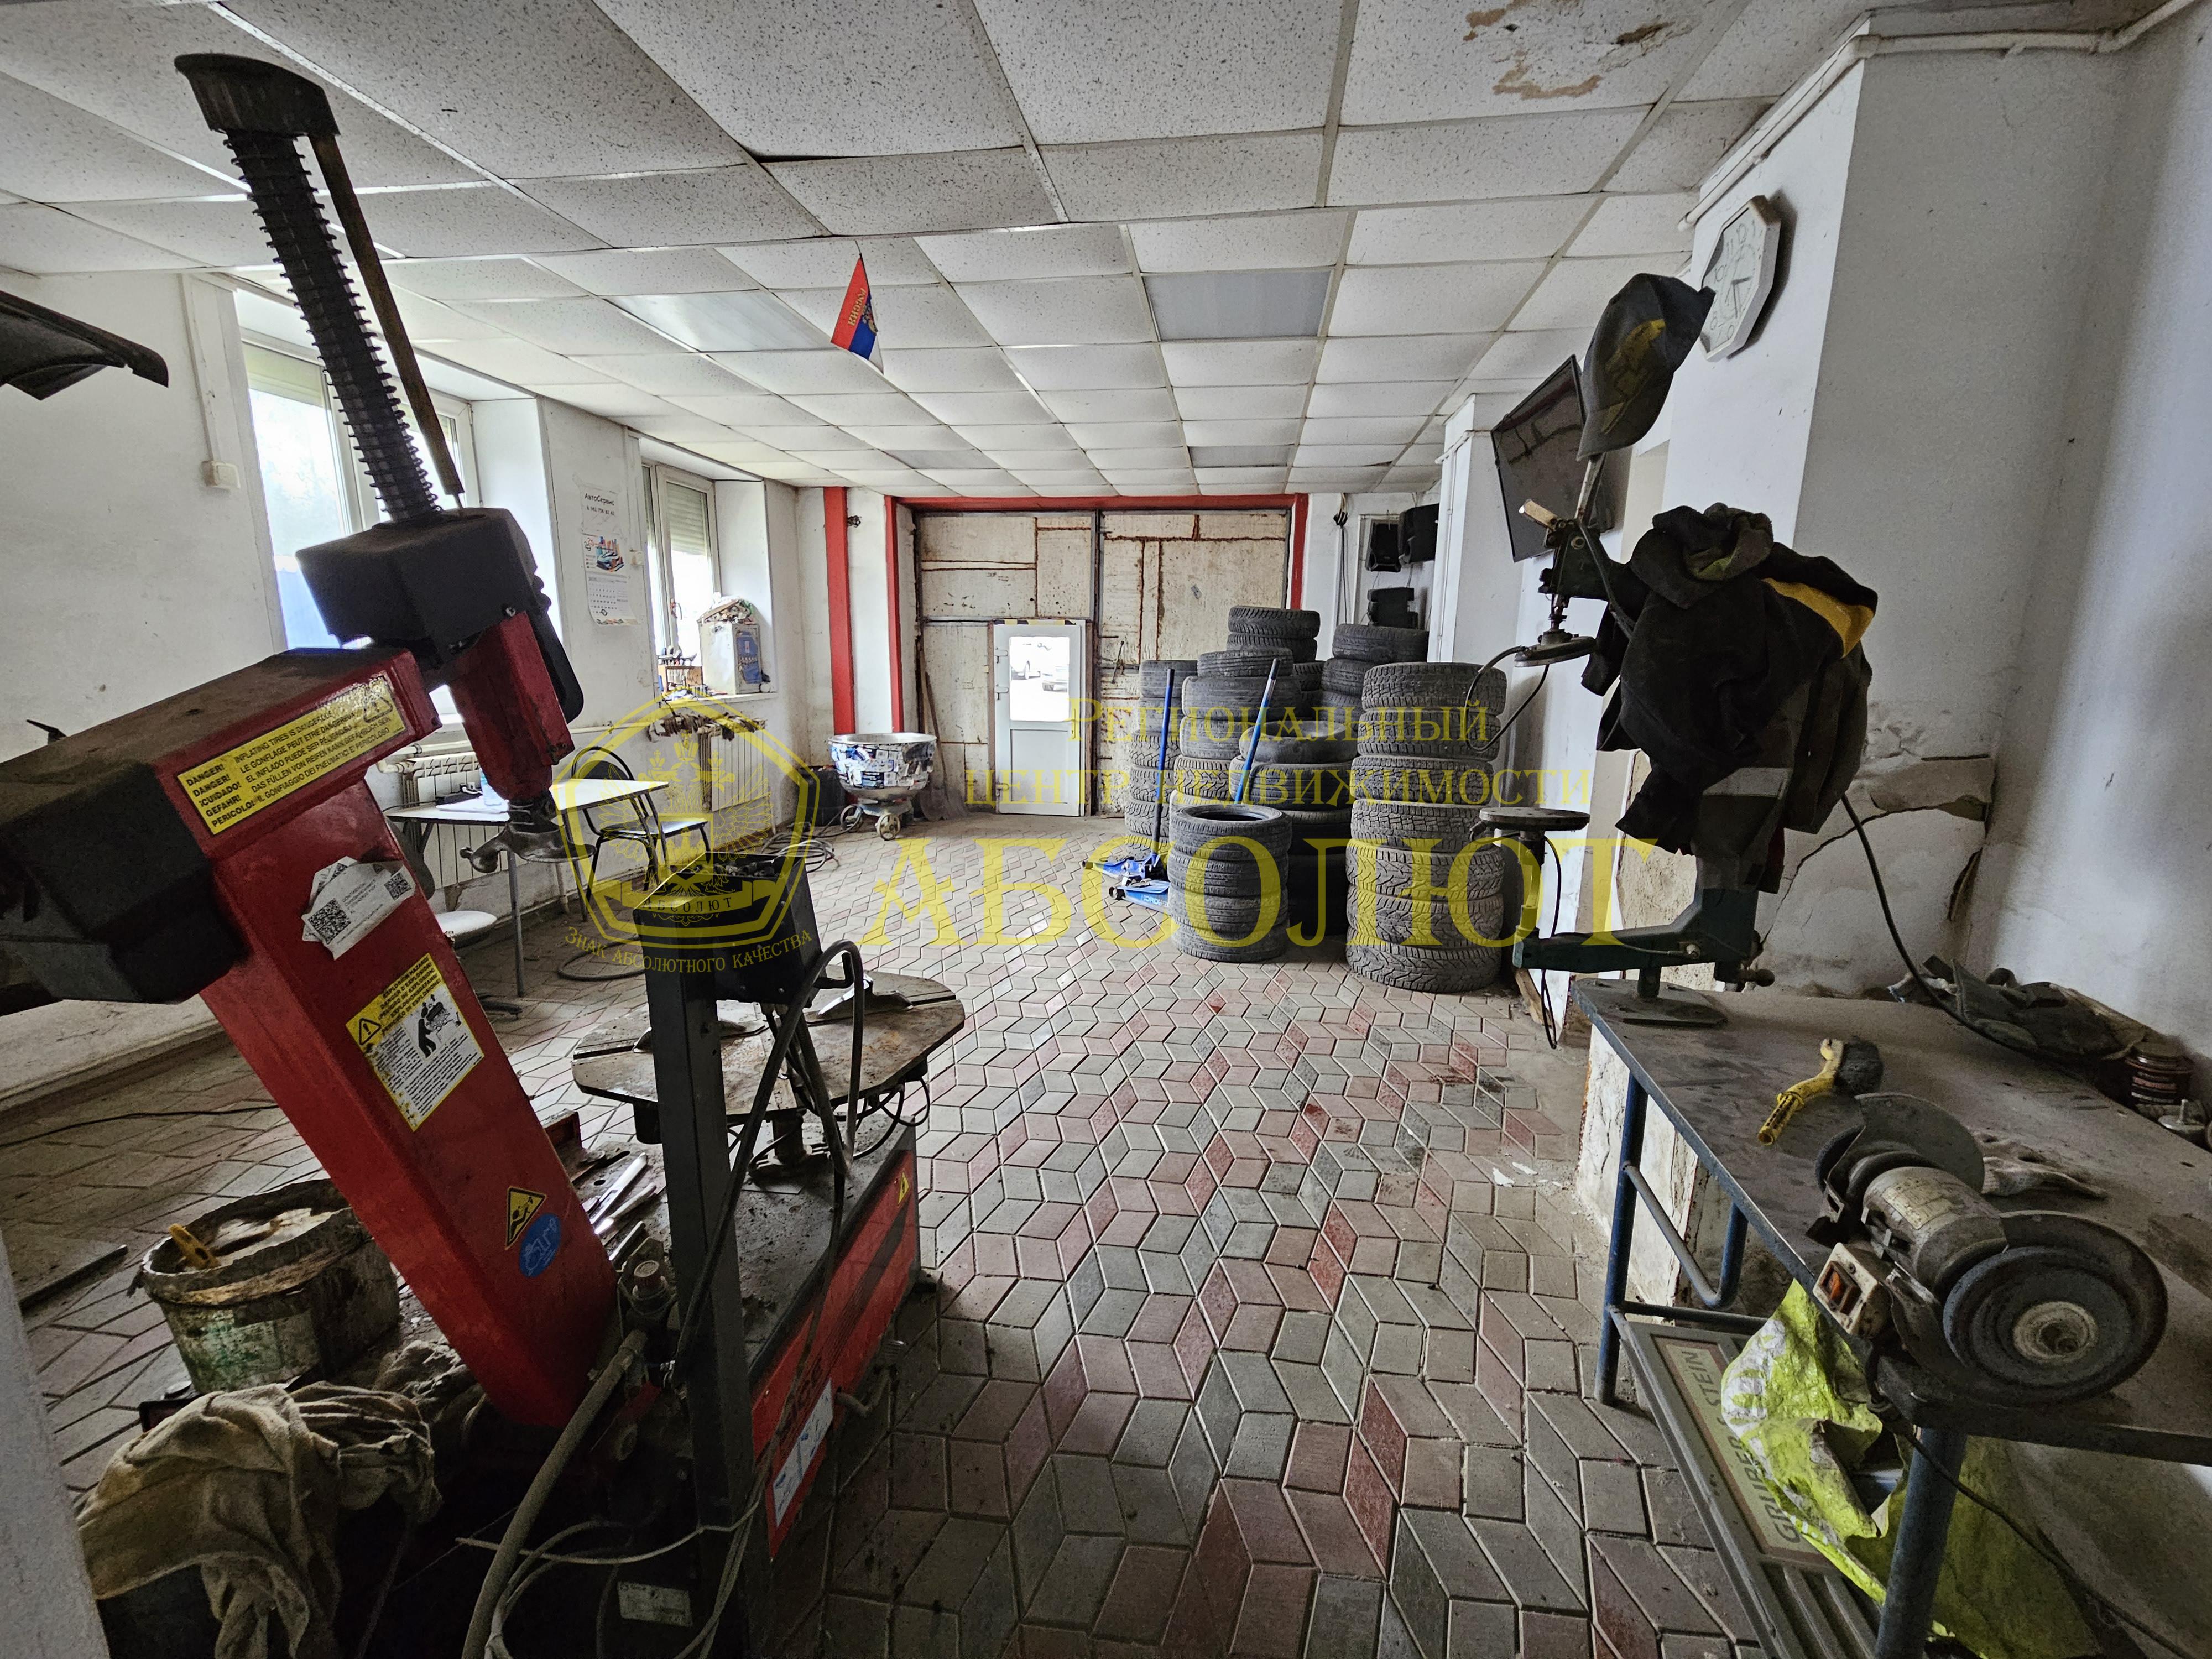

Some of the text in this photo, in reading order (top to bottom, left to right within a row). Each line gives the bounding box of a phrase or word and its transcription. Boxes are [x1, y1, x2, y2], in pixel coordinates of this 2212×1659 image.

[233, 741, 269, 764] INFLATING
[268, 732, 289, 747] TIRES
[239, 764, 251, 774] LE
[249, 745, 287, 769] GONFLAGE
[286, 737, 304, 750] PEUT
[320, 710, 356, 734] DANGEREUX
[245, 723, 352, 783] EL INFLADO PUEDE SER PELIGROSO
[185, 762, 225, 787] DANGER!
[251, 780, 267, 793] DAS
[264, 765, 291, 785] FÜLLEN
[290, 759, 306, 772] VON
[305, 748, 327, 765] REIFEN
[327, 739, 345, 754] KANN
[264, 772, 305, 799] GONFIAGGIO
[304, 766, 316, 778] DEI
[315, 748, 350, 771] PNEUMATICI
[355, 726, 390, 750] PERICOLOSO
[192, 773, 231, 797] DANGER!
[205, 794, 242, 817] GEFAHR!
[211, 799, 255, 827] PERICOLO!
